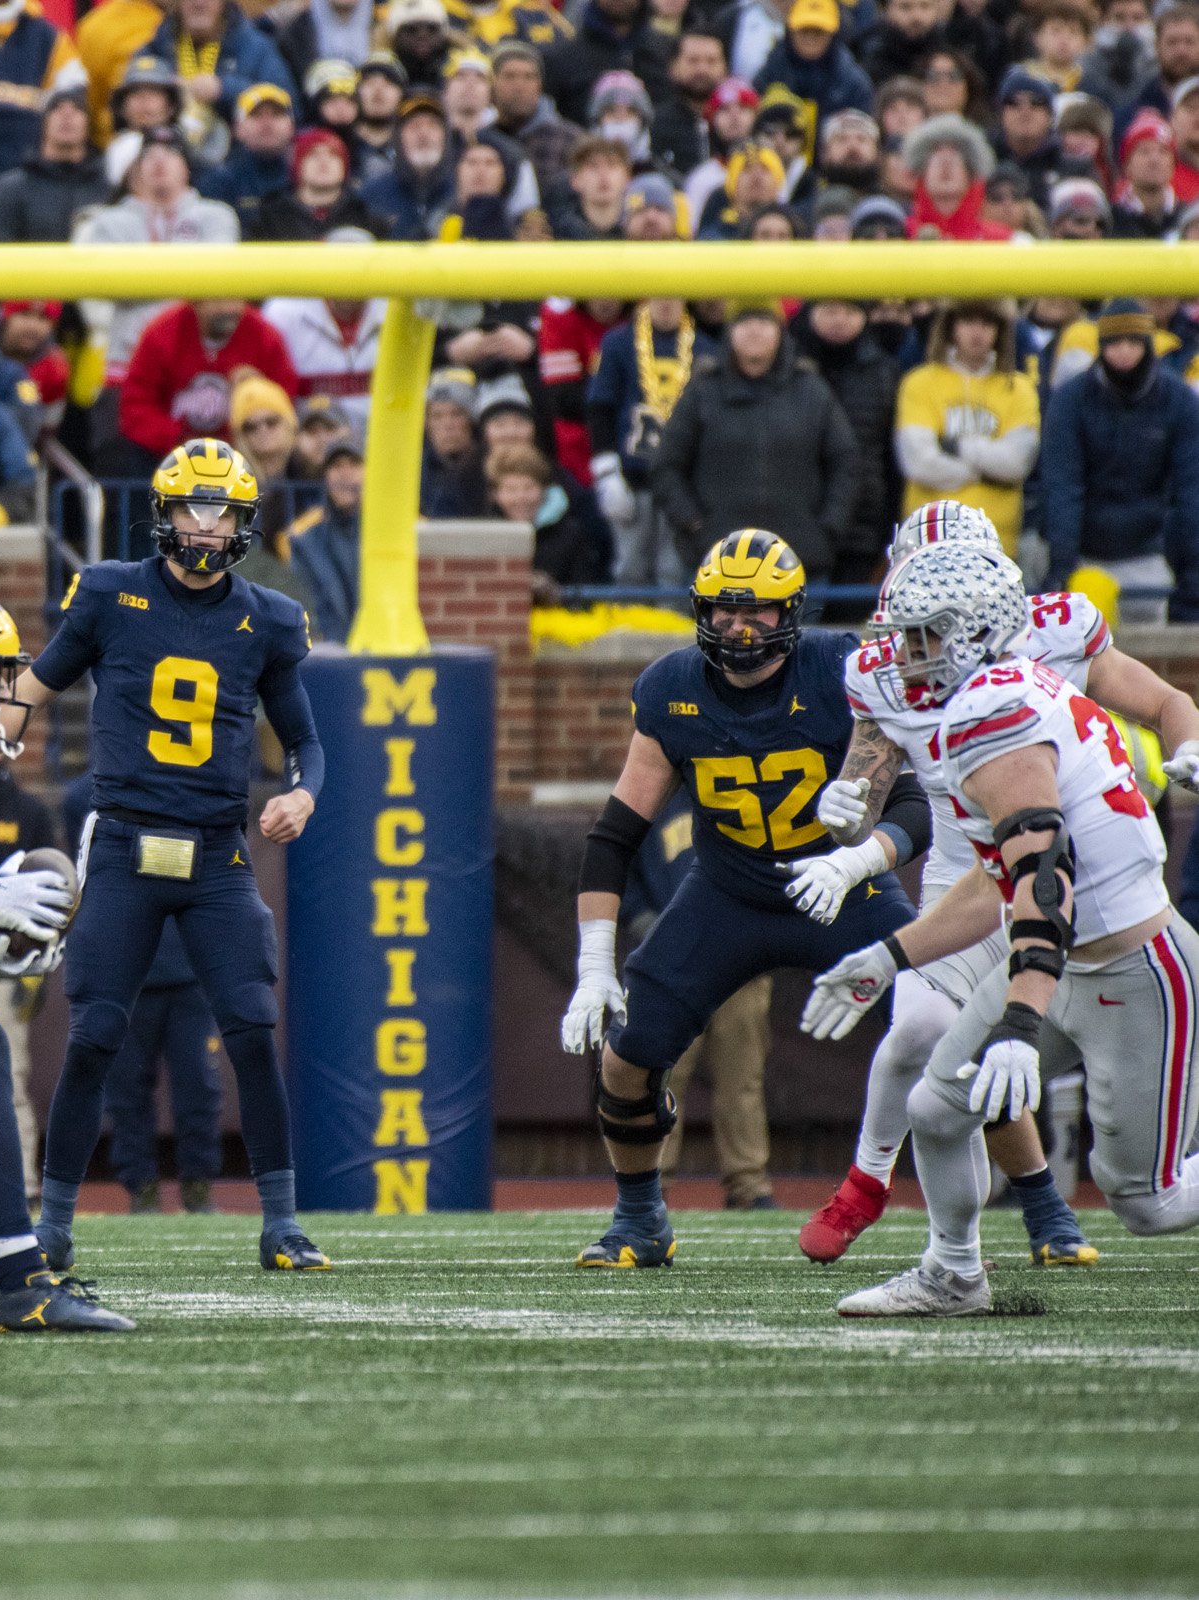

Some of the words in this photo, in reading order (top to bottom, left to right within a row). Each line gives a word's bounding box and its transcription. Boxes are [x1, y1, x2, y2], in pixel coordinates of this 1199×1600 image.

[148, 656, 219, 767] 9
[691, 747, 829, 851] 52
[361, 667, 438, 1215] MICHIGAN
